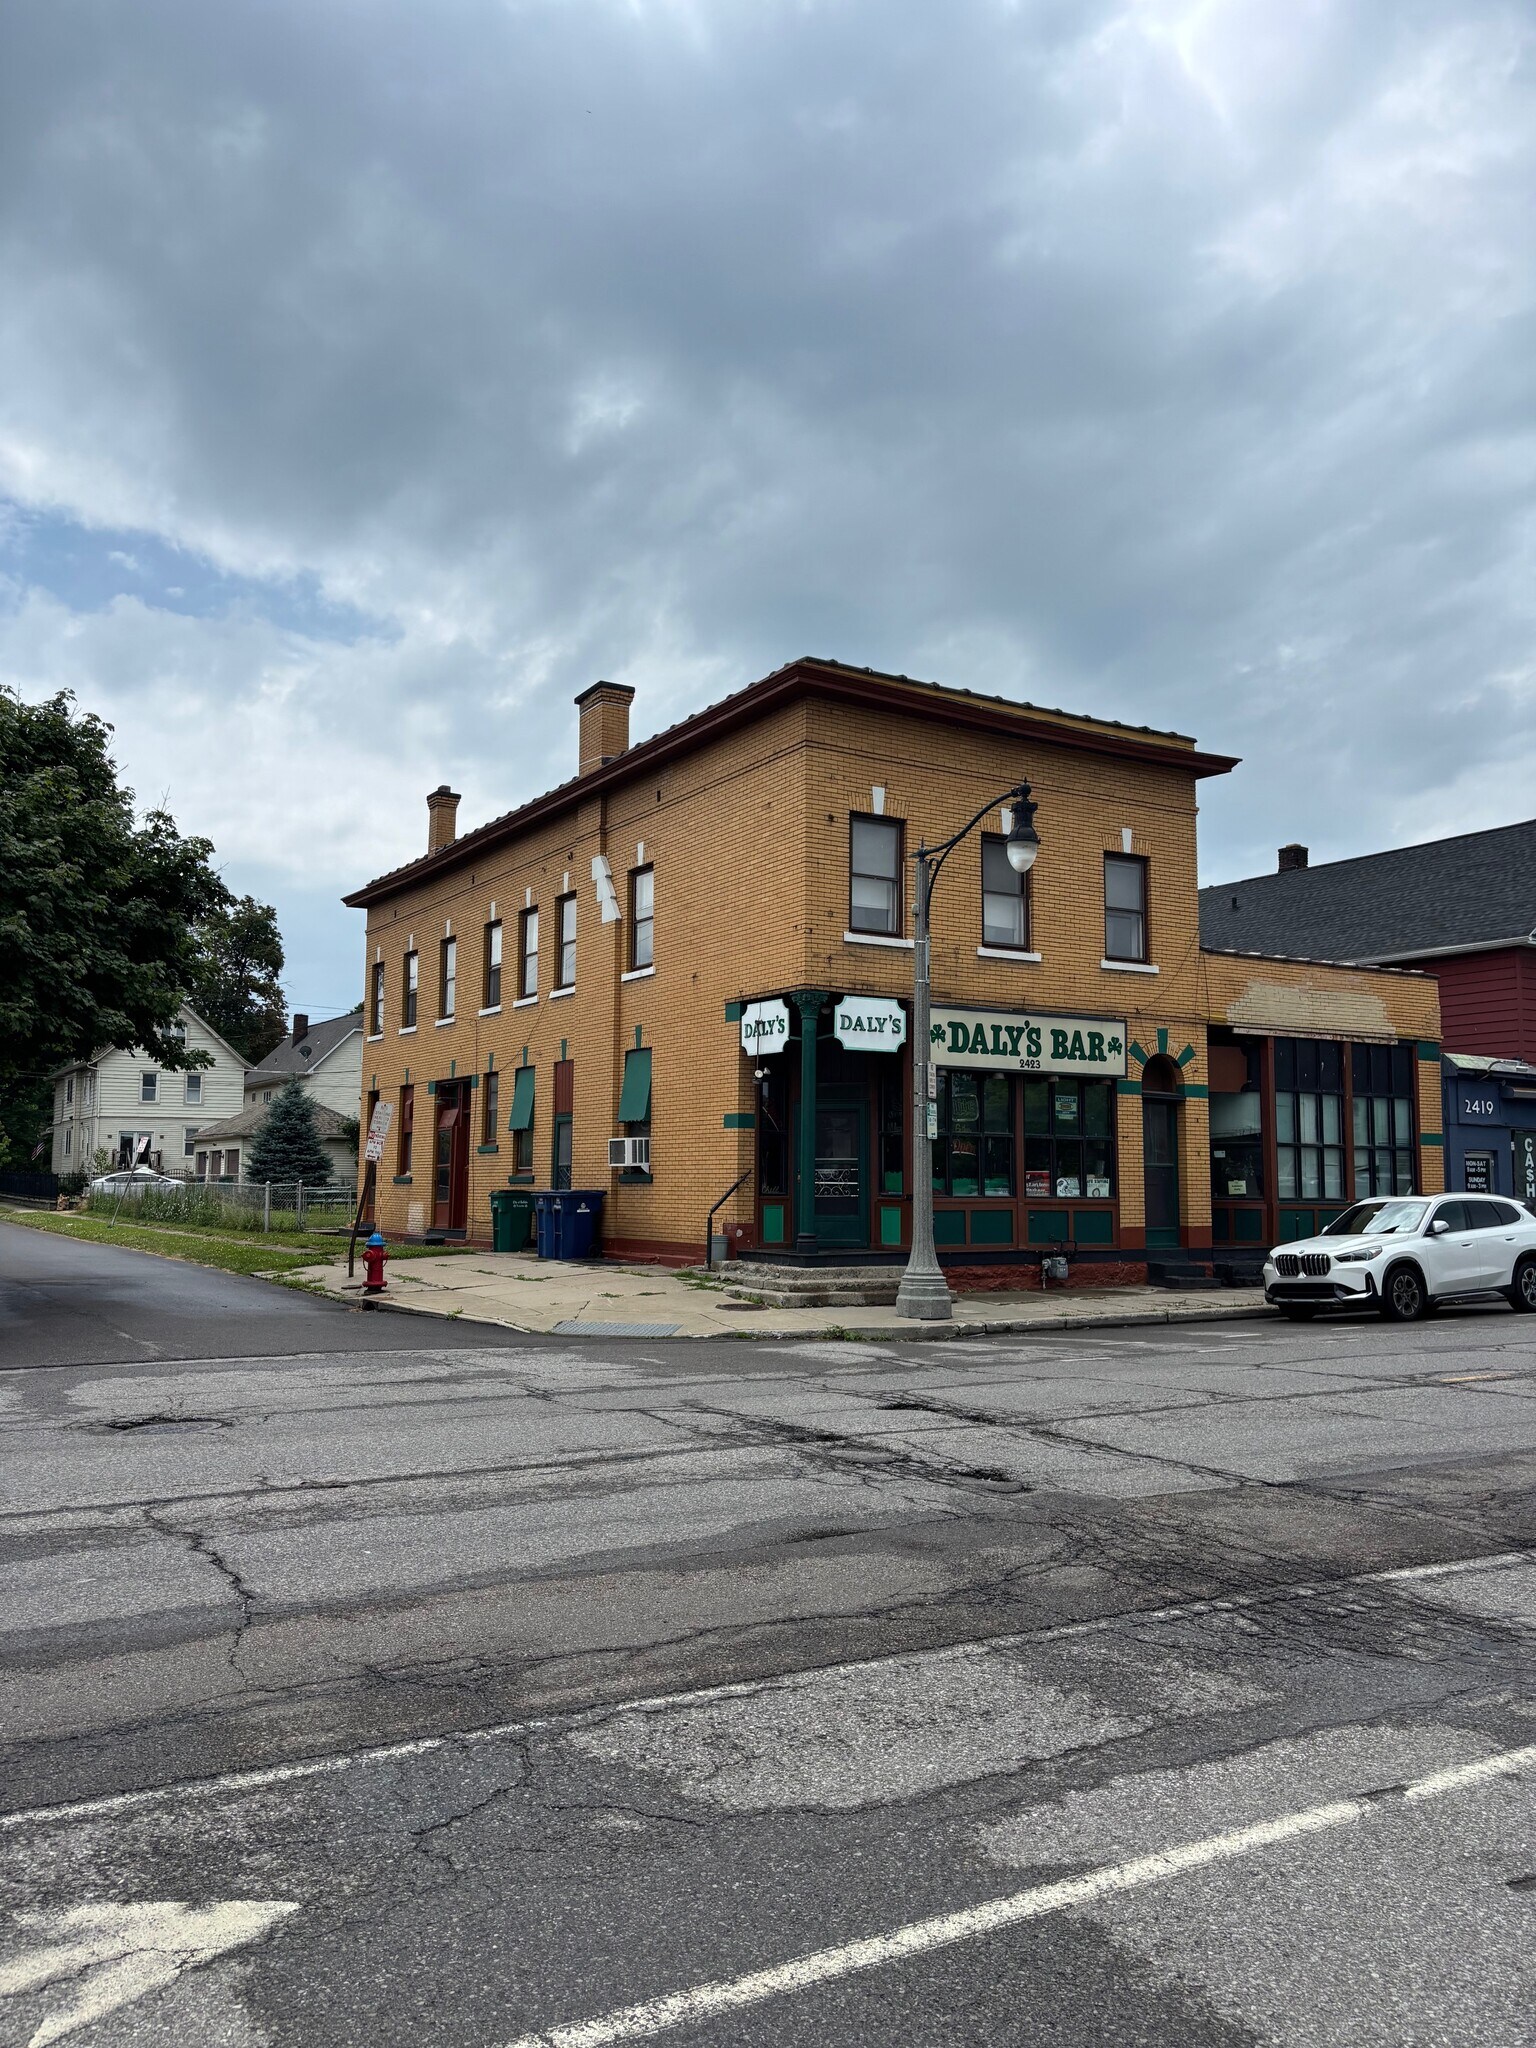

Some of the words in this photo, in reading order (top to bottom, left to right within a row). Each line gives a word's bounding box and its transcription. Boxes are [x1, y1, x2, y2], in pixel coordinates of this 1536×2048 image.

[744, 1015, 786, 1039] DALY'S
[840, 1014, 902, 1034] DALY'S
[947, 1020, 1042, 1058] DALY'S
[1050, 1028, 1108, 1062] BAR
[1019, 1059, 1041, 1069] 2423
[1465, 1099, 1494, 1115] 2419
[1524, 1138, 1536, 1198] CASH
